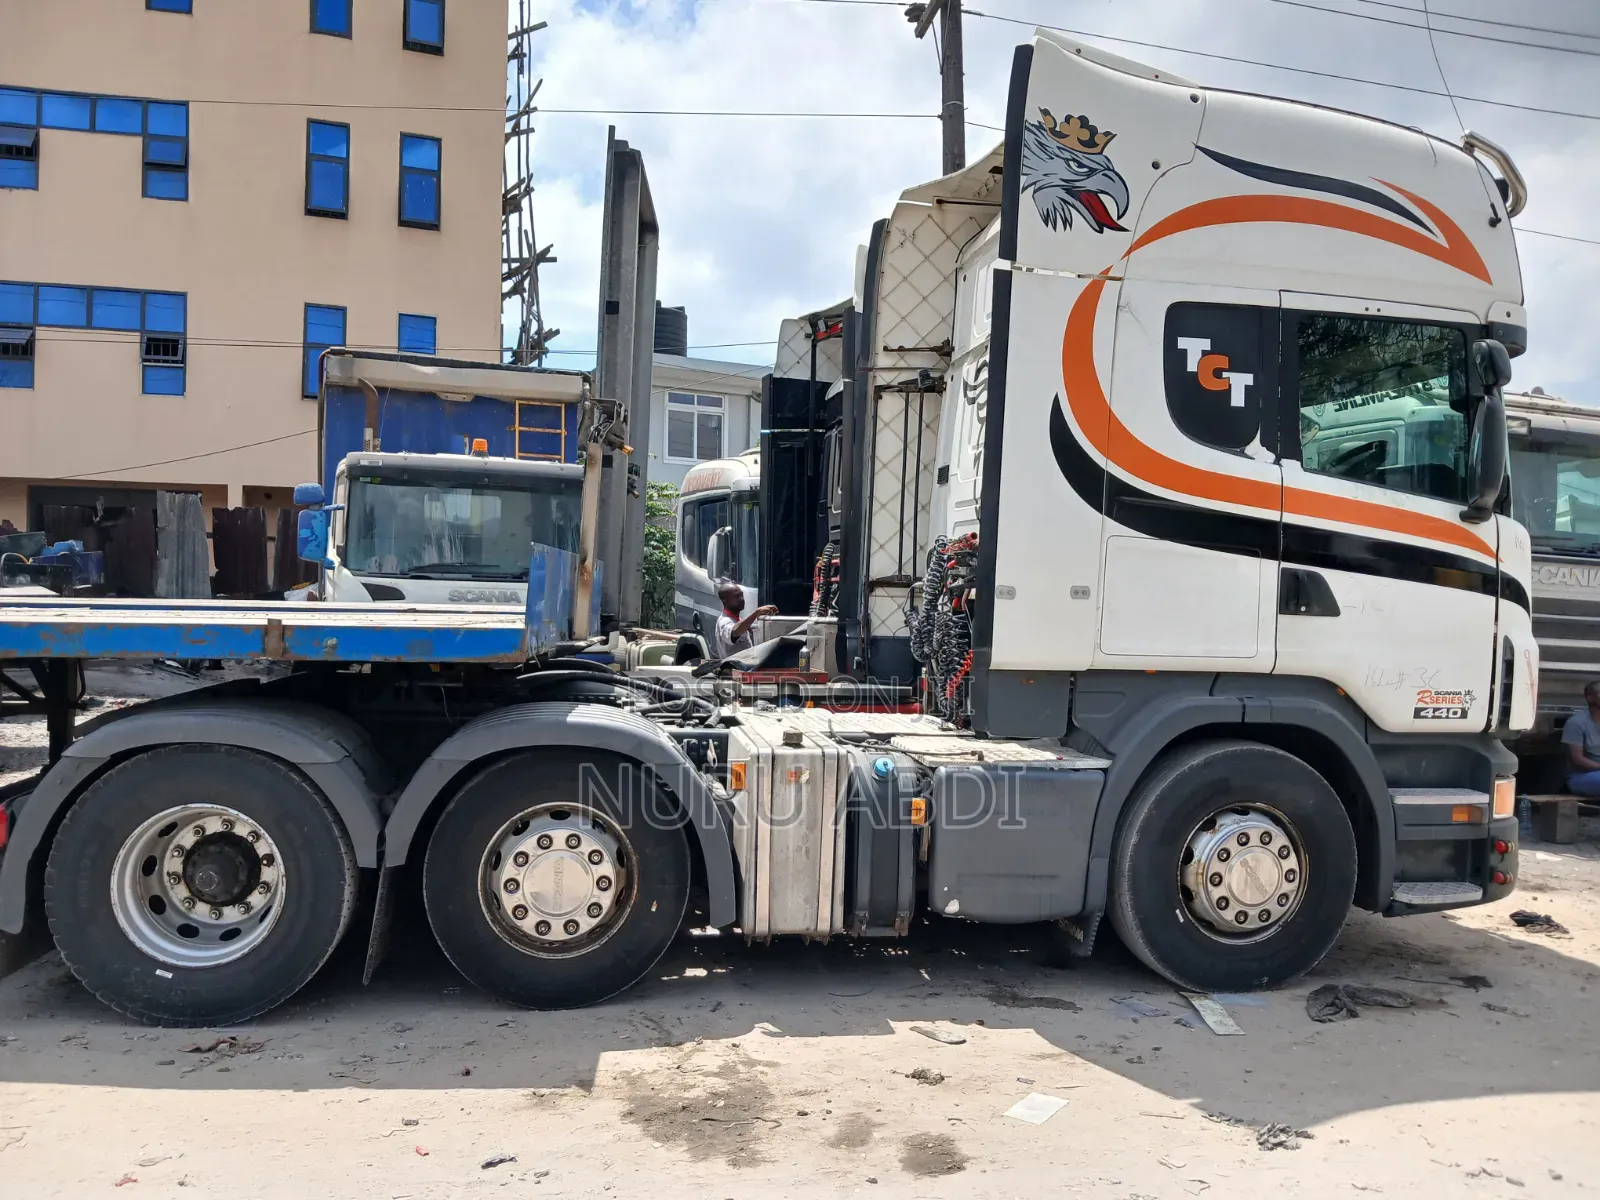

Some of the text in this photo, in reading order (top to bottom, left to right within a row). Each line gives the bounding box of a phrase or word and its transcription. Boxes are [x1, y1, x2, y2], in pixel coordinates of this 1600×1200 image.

[1532, 565, 1600, 587] CANI
[448, 589, 522, 604] SCANIA
[1420, 708, 1461, 718] 440
